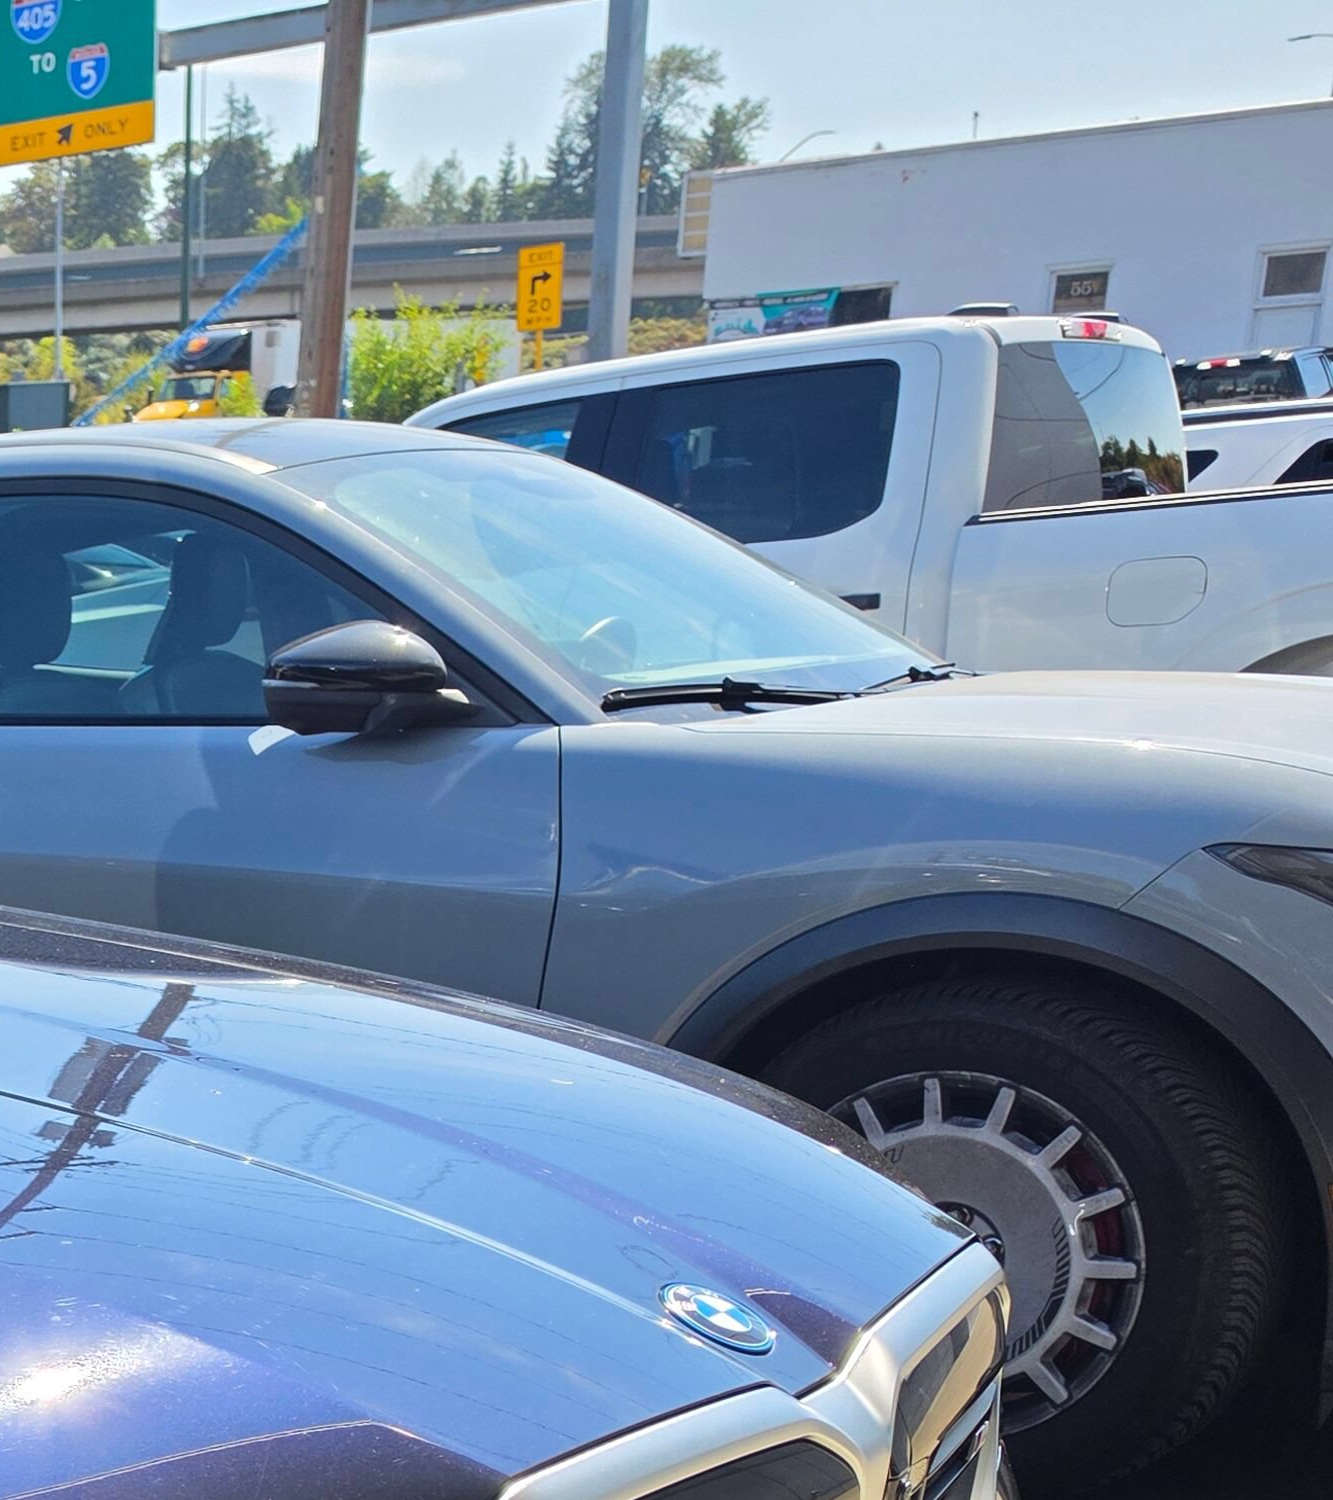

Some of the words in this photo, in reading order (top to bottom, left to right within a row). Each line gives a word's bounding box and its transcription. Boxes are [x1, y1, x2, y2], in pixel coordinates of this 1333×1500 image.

[18, 4, 56, 32] 405
[30, 52, 56, 74] TO
[80, 61, 97, 90] 5
[10, 132, 45, 151] EXIT
[85, 119, 129, 138] ONLY
[528, 298, 551, 313] 20
